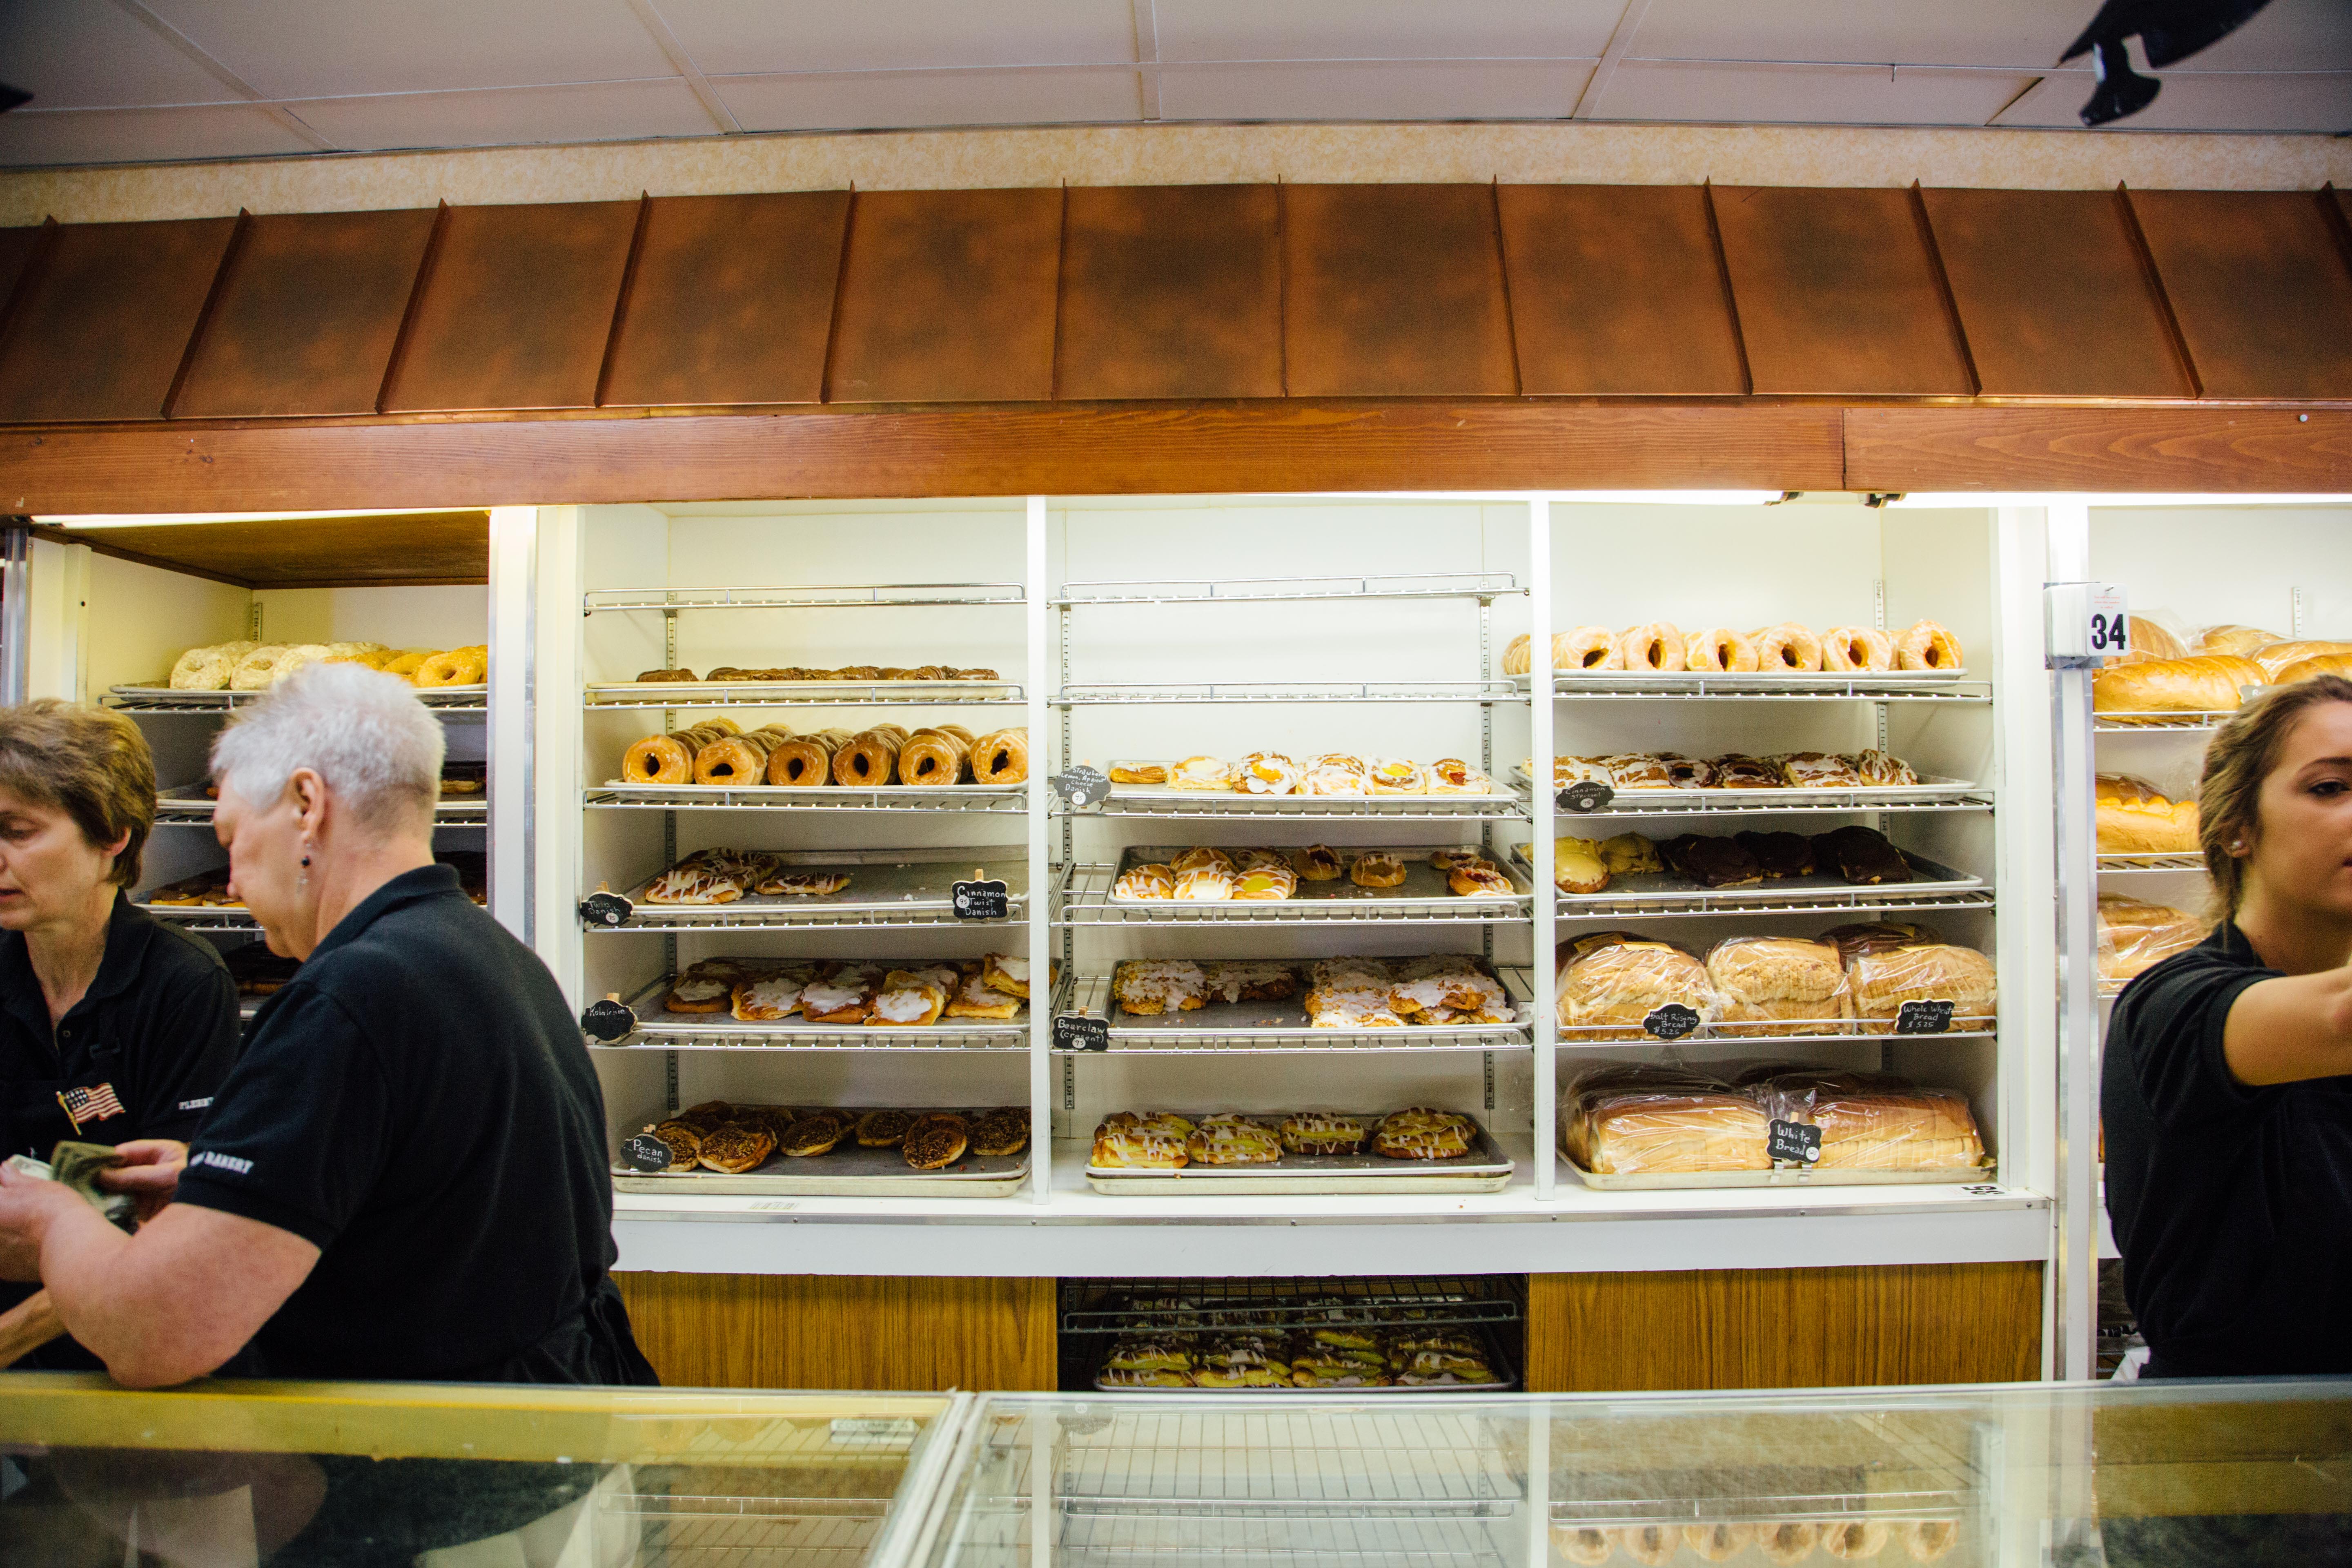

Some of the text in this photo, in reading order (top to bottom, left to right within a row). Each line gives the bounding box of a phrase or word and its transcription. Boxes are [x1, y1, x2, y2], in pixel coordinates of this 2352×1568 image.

[2091, 614, 2126, 650] 34
[1065, 784, 1091, 794] Danish
[957, 885, 1006, 898] Cinnamon
[968, 898, 995, 906] Twist
[965, 907, 997, 916] Danish
[1931, 1003, 1953, 1015] Wheat
[1650, 1012, 1697, 1024] Salt Rising
[1058, 1019, 1105, 1034] Bearclaw
[1060, 1029, 1104, 1043] (cresent)
[1777, 1124, 1810, 1143] White
[633, 1139, 663, 1157] Pecan
[1775, 1138, 1806, 1155] Bread
[205, 1151, 254, 1174] BAKERY
[637, 1152, 662, 1164] danish
